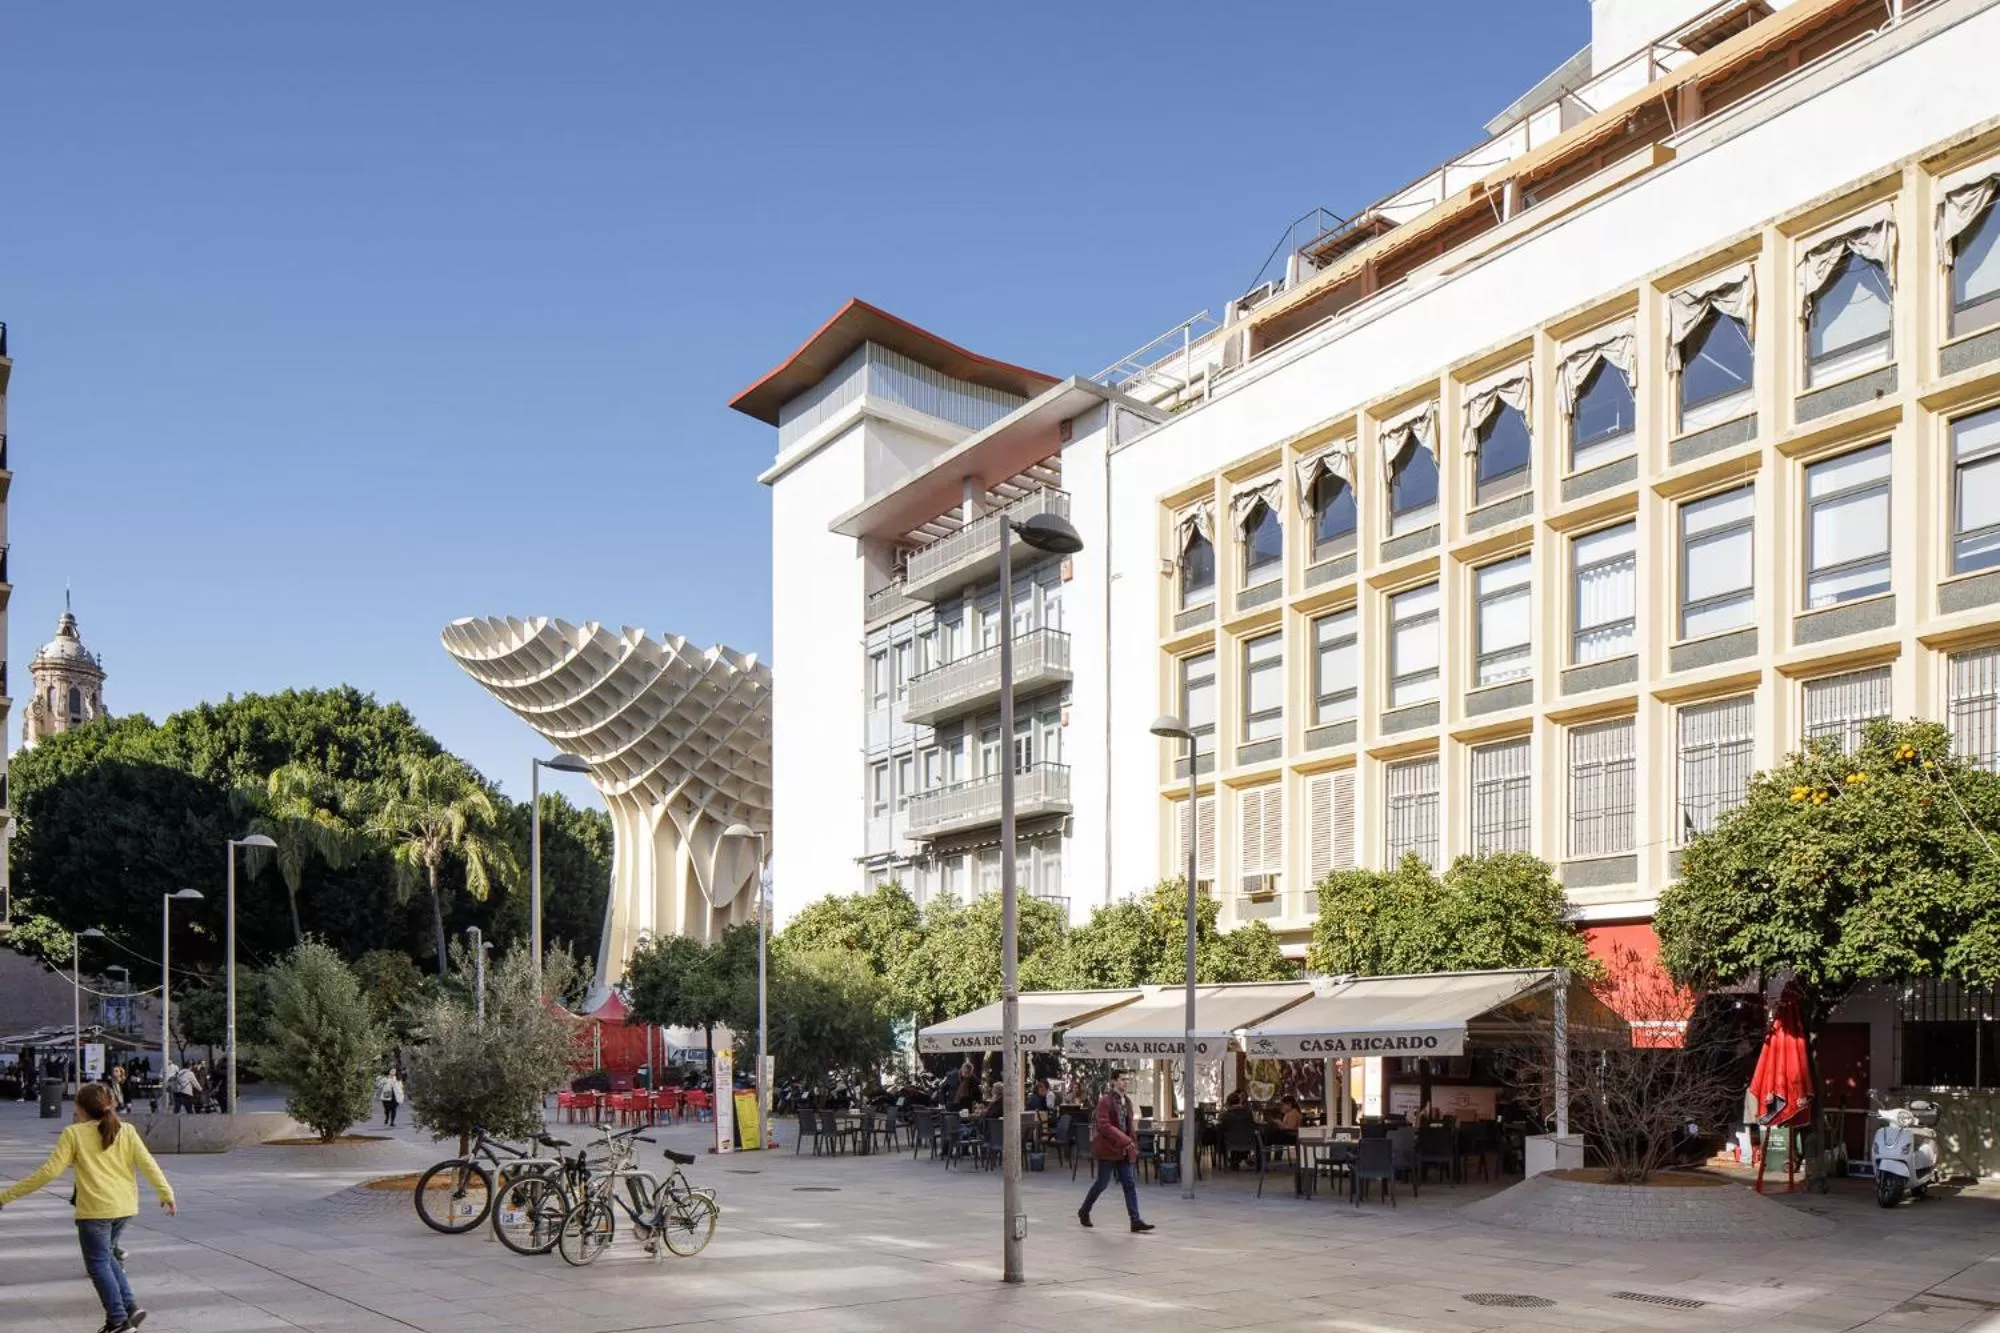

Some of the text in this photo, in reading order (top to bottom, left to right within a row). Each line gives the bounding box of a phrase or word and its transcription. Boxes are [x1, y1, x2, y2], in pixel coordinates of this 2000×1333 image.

[952, 1037, 981, 1047] CASA
[984, 1034, 1037, 1046] RICDO
[1300, 1035, 1438, 1052] CASA RICARDO
[1104, 1042, 1208, 1054] CASA RICARO
